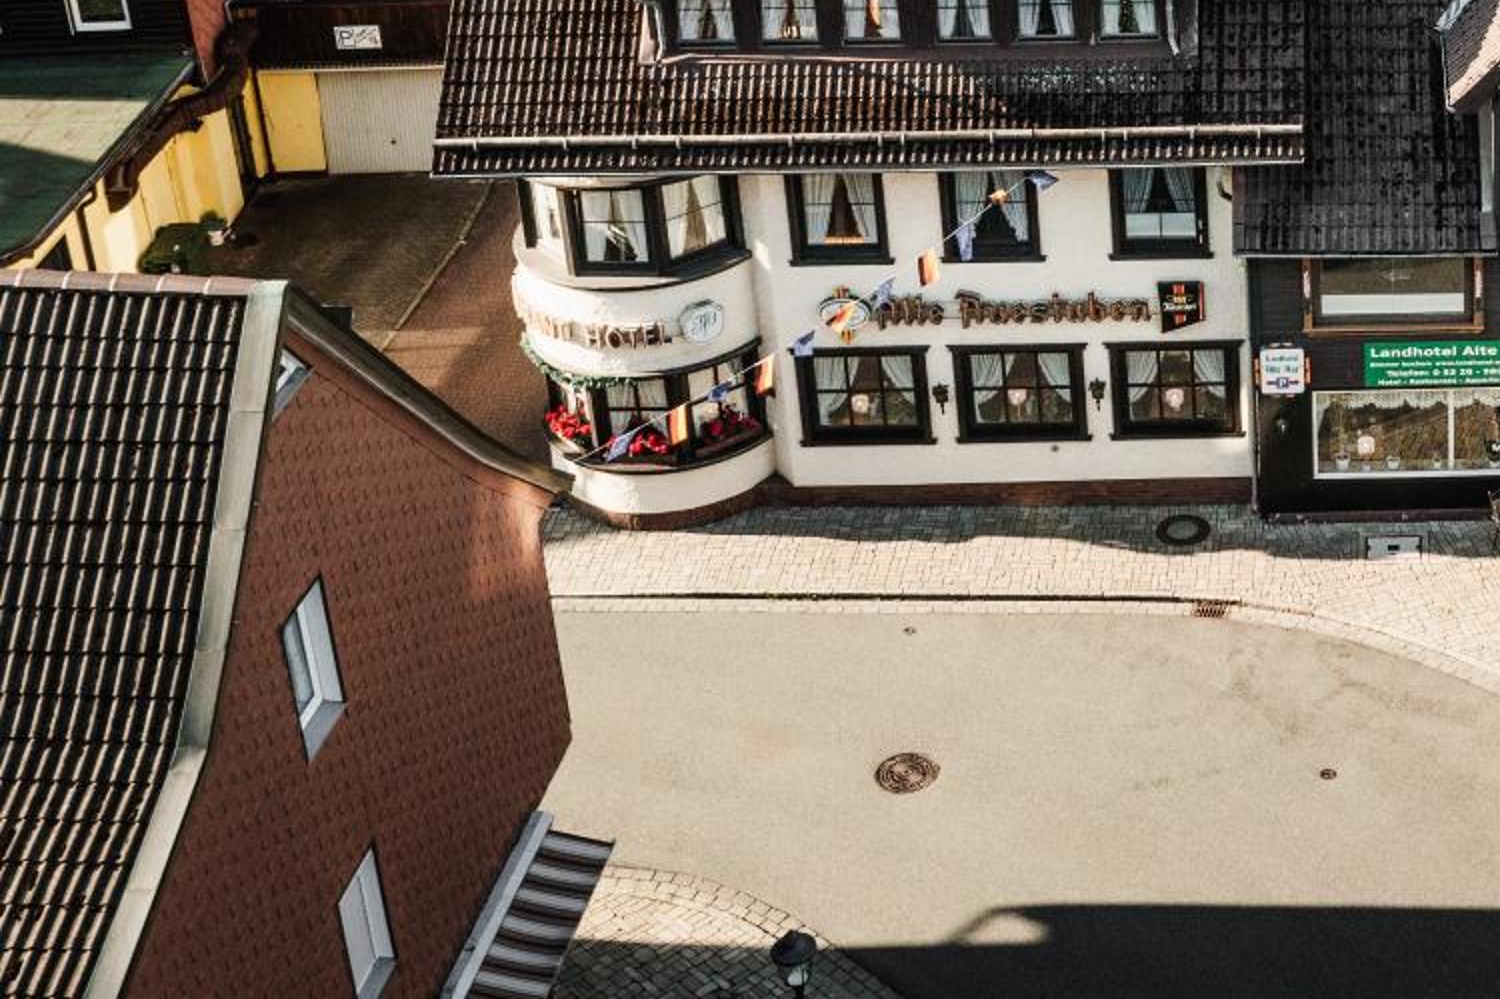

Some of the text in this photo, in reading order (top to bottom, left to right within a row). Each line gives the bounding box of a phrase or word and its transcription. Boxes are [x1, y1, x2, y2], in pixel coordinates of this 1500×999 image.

[584, 320, 674, 349] HOTEL
[1370, 345, 1457, 359] Landhotel
[1462, 344, 1498, 357] Alte
